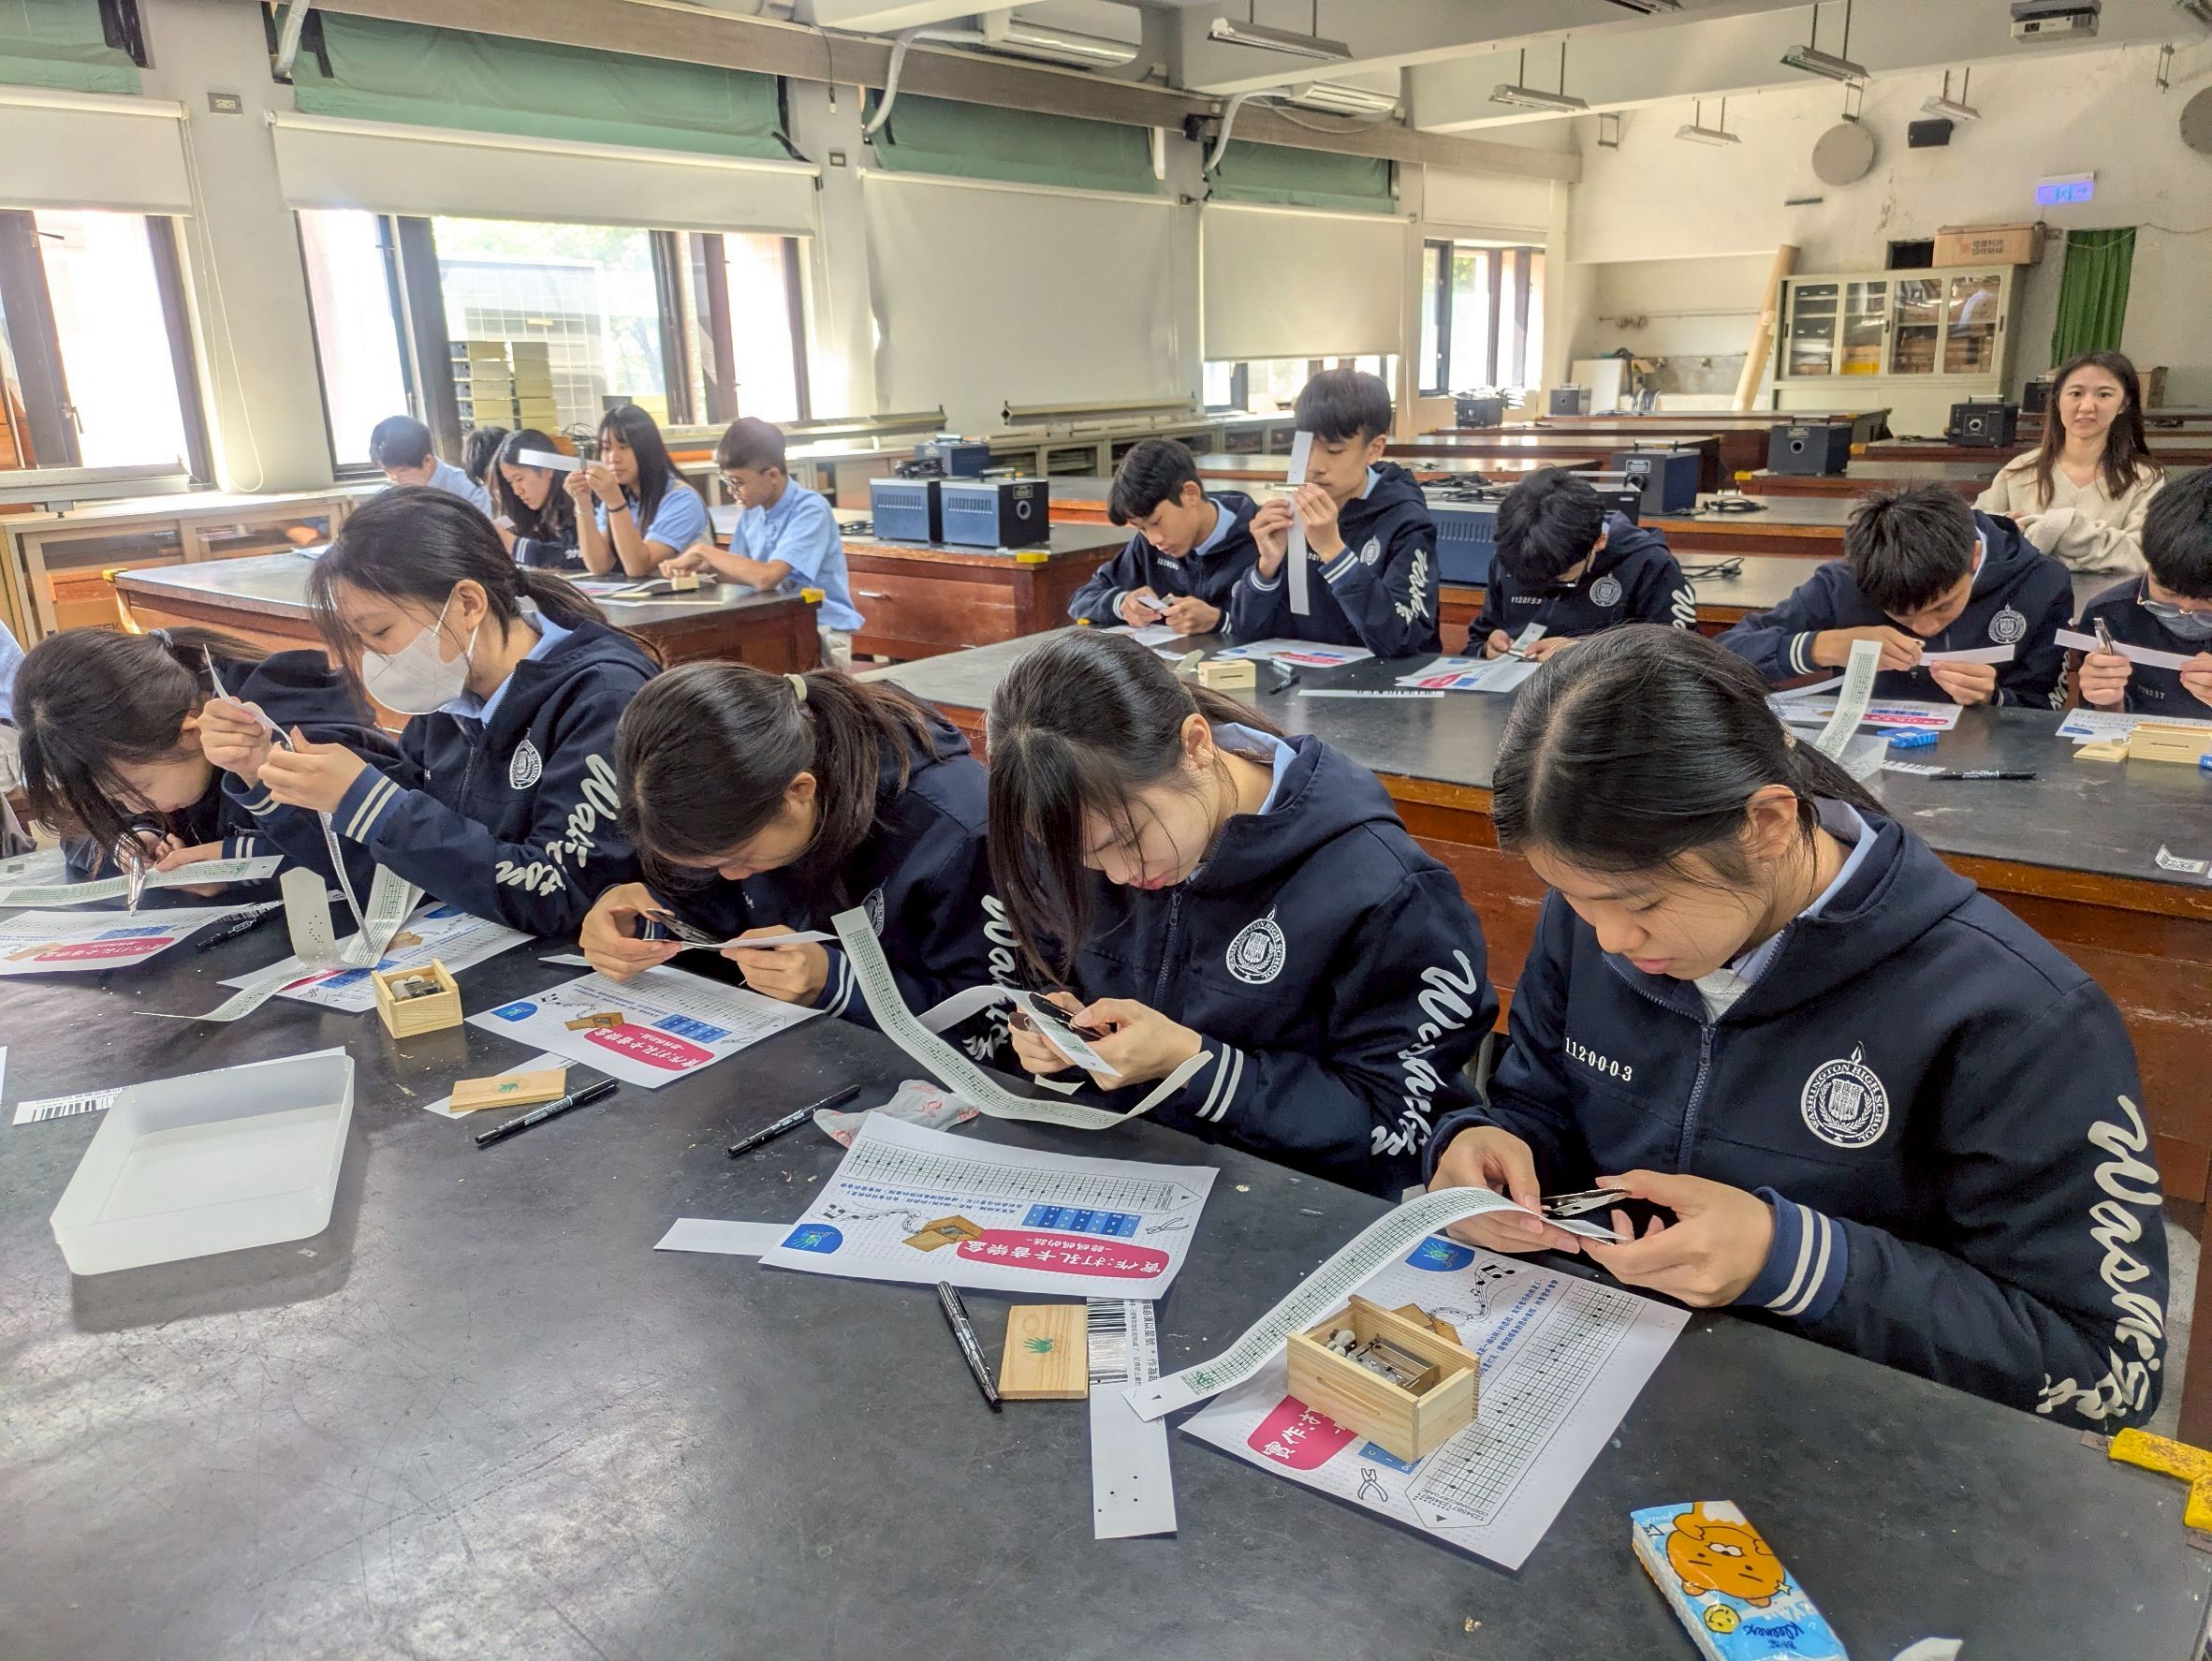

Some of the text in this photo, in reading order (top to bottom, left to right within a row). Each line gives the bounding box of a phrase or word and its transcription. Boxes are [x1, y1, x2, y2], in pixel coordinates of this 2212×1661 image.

[1266, 921, 1282, 943] HIGH
[1261, 943, 1282, 980] SCHOOL
[1565, 1037, 1633, 1081] 1120003
[1806, 1064, 1883, 1142] WASHINGTON HIGH SCHOOL
[1742, 1622, 1804, 1640] Kleenex
